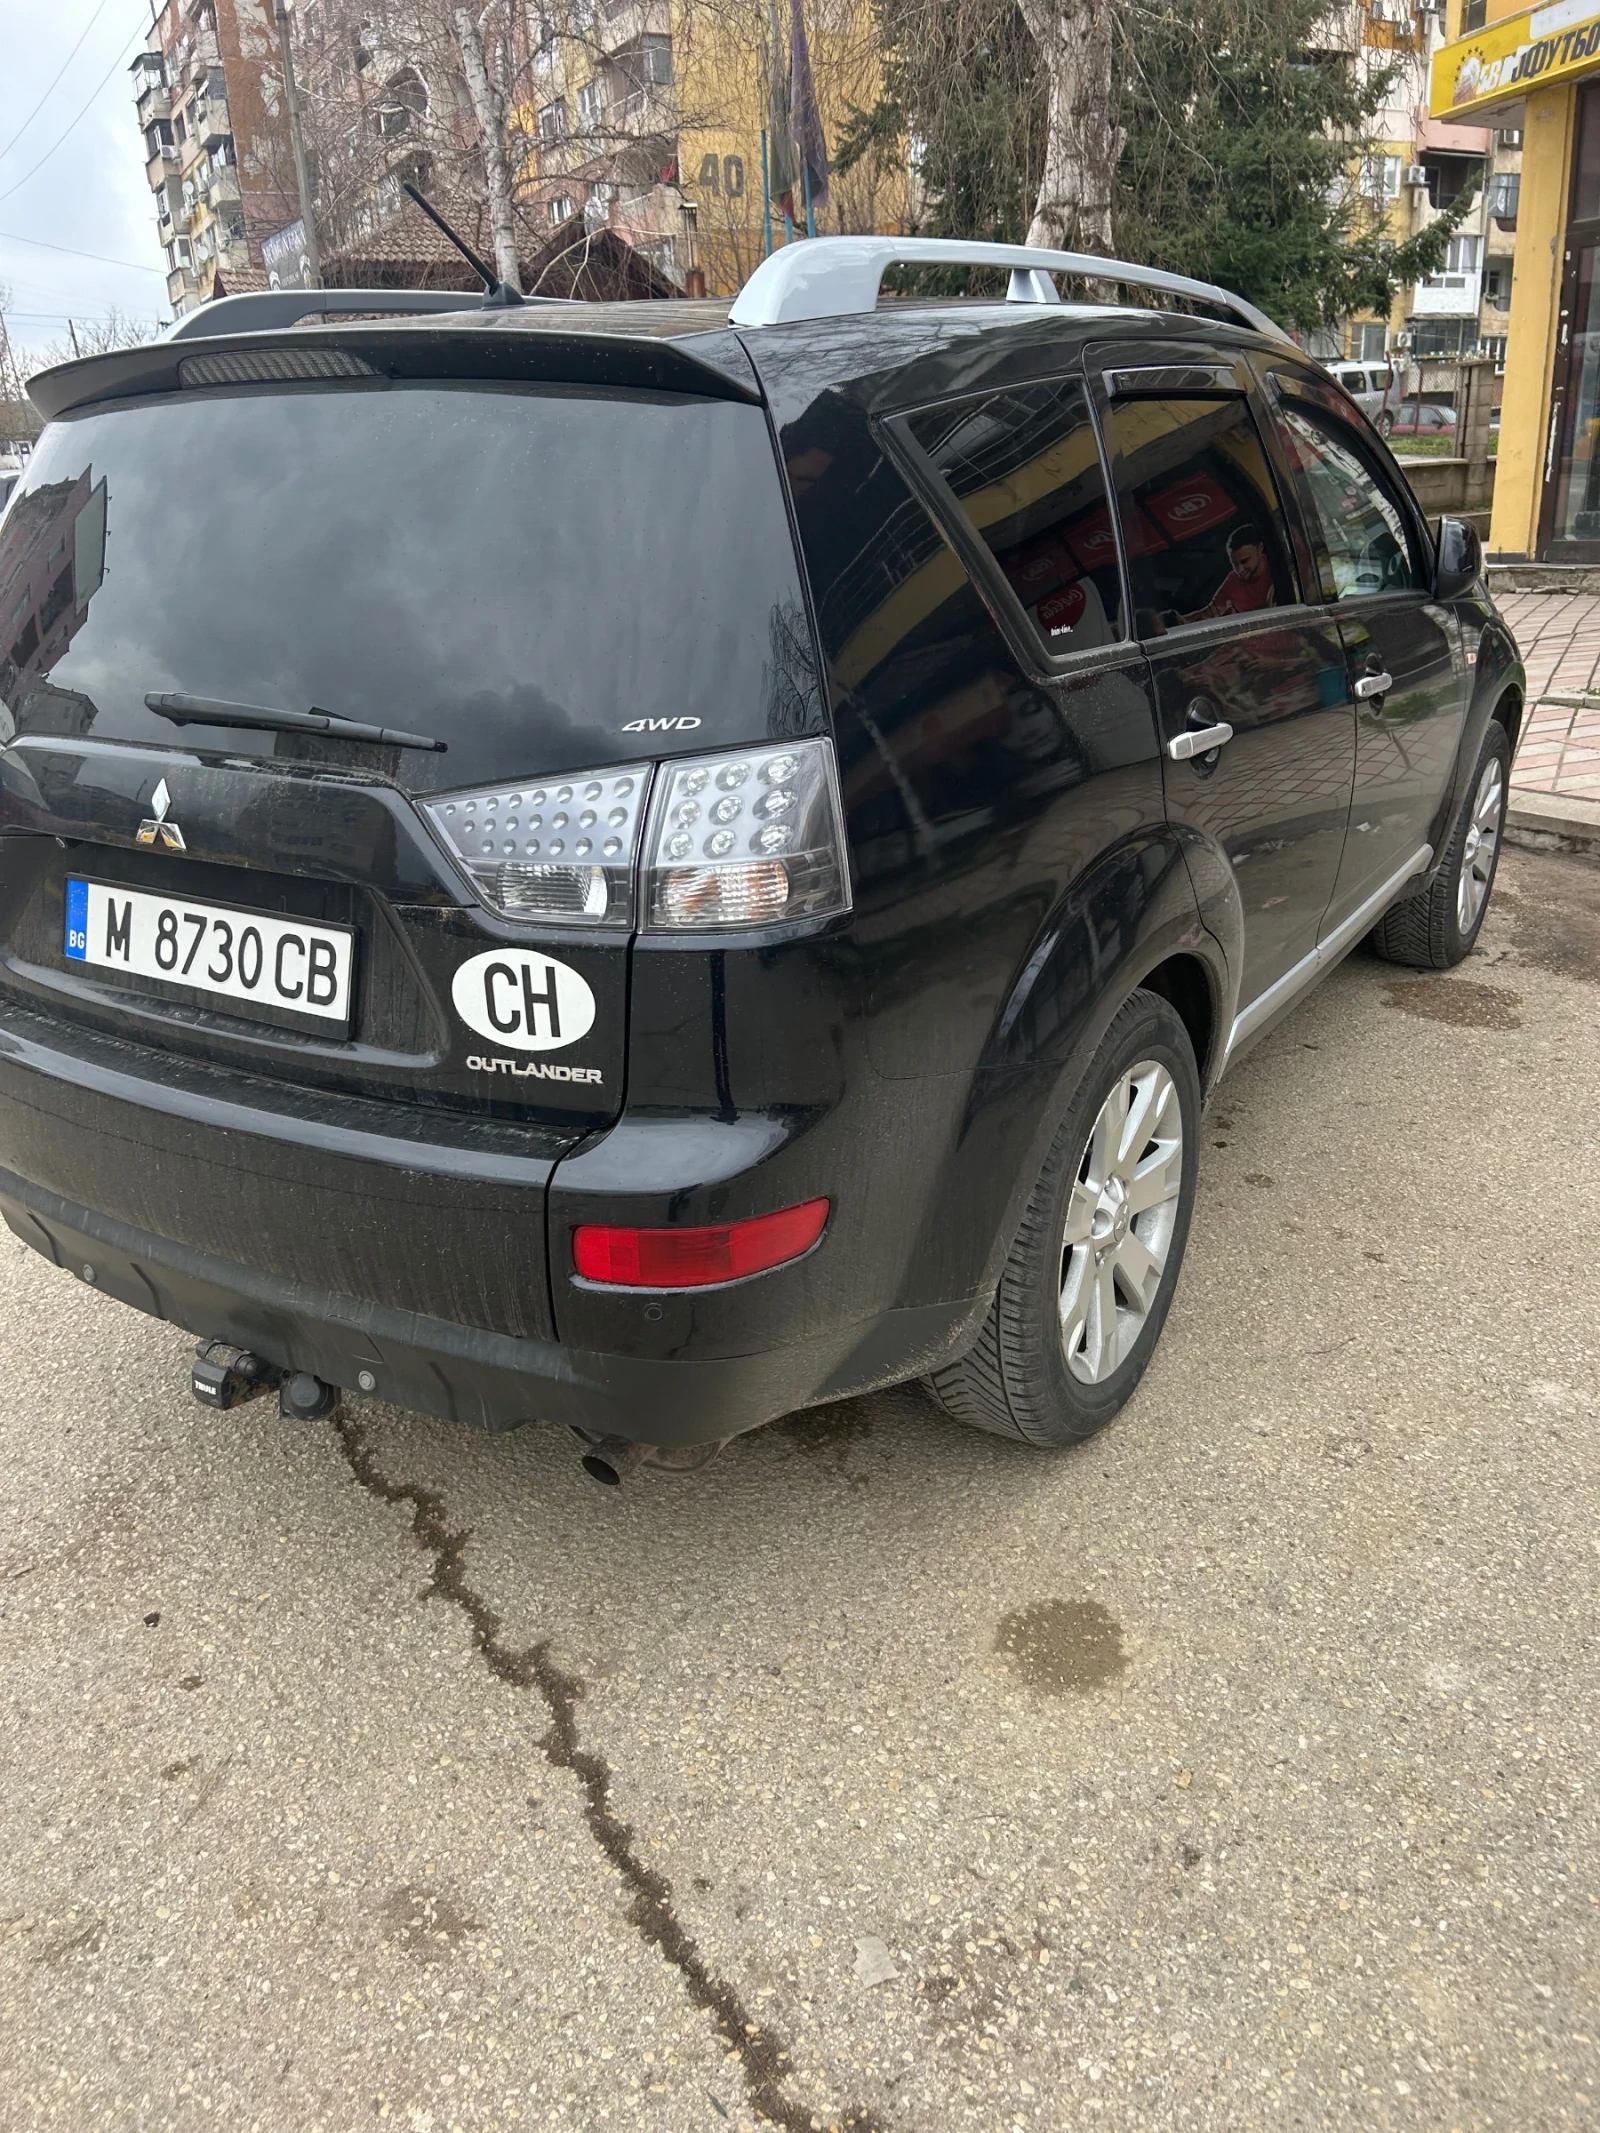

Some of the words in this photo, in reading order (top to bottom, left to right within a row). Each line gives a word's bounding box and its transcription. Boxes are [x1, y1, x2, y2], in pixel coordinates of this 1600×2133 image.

[699, 153, 744, 198] 40
[621, 716, 702, 732] 4WD
[69, 929, 86, 950] BG
[106, 897, 132, 962] M
[155, 909, 263, 989] 8730
[274, 933, 338, 1007] CB
[484, 962, 561, 1038] CH
[466, 1055, 604, 1085] OUTLANDER
[194, 1379, 217, 1395] THULE
